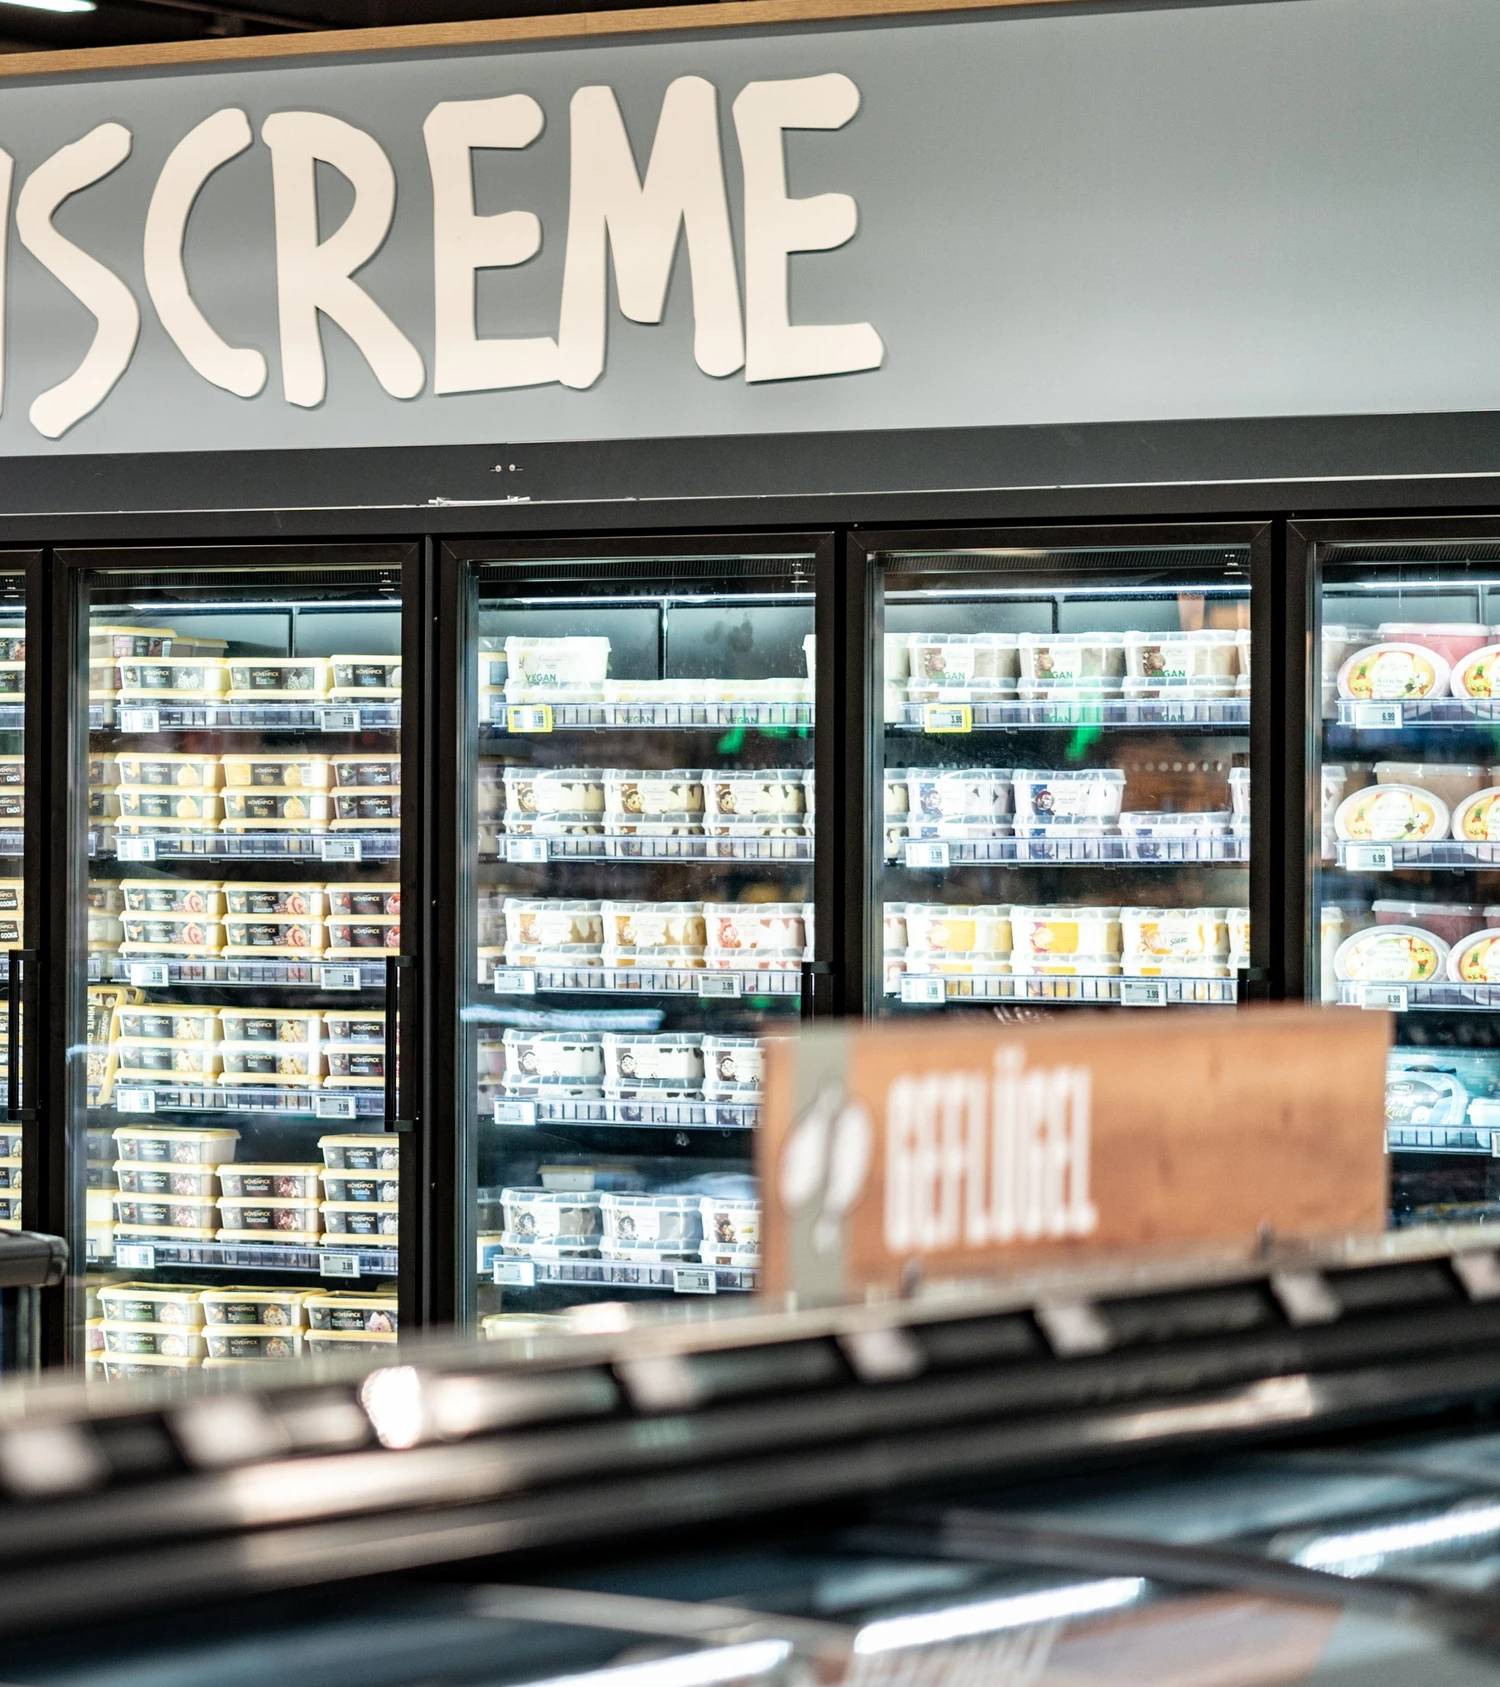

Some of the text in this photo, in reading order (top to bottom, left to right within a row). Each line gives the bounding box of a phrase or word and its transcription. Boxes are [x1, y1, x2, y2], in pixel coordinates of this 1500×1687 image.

[525, 674, 556, 682] VEGAN
[343, 717, 354, 725] 3.99
[951, 715, 962, 724] 3.99
[1382, 713, 1395, 721] 6.99
[1372, 854, 1385, 863] 6.99
[343, 974, 354, 983] 3.99
[1146, 990, 1158, 999] 3.99
[884, 1044, 1098, 1252] GEFLÜGEL
